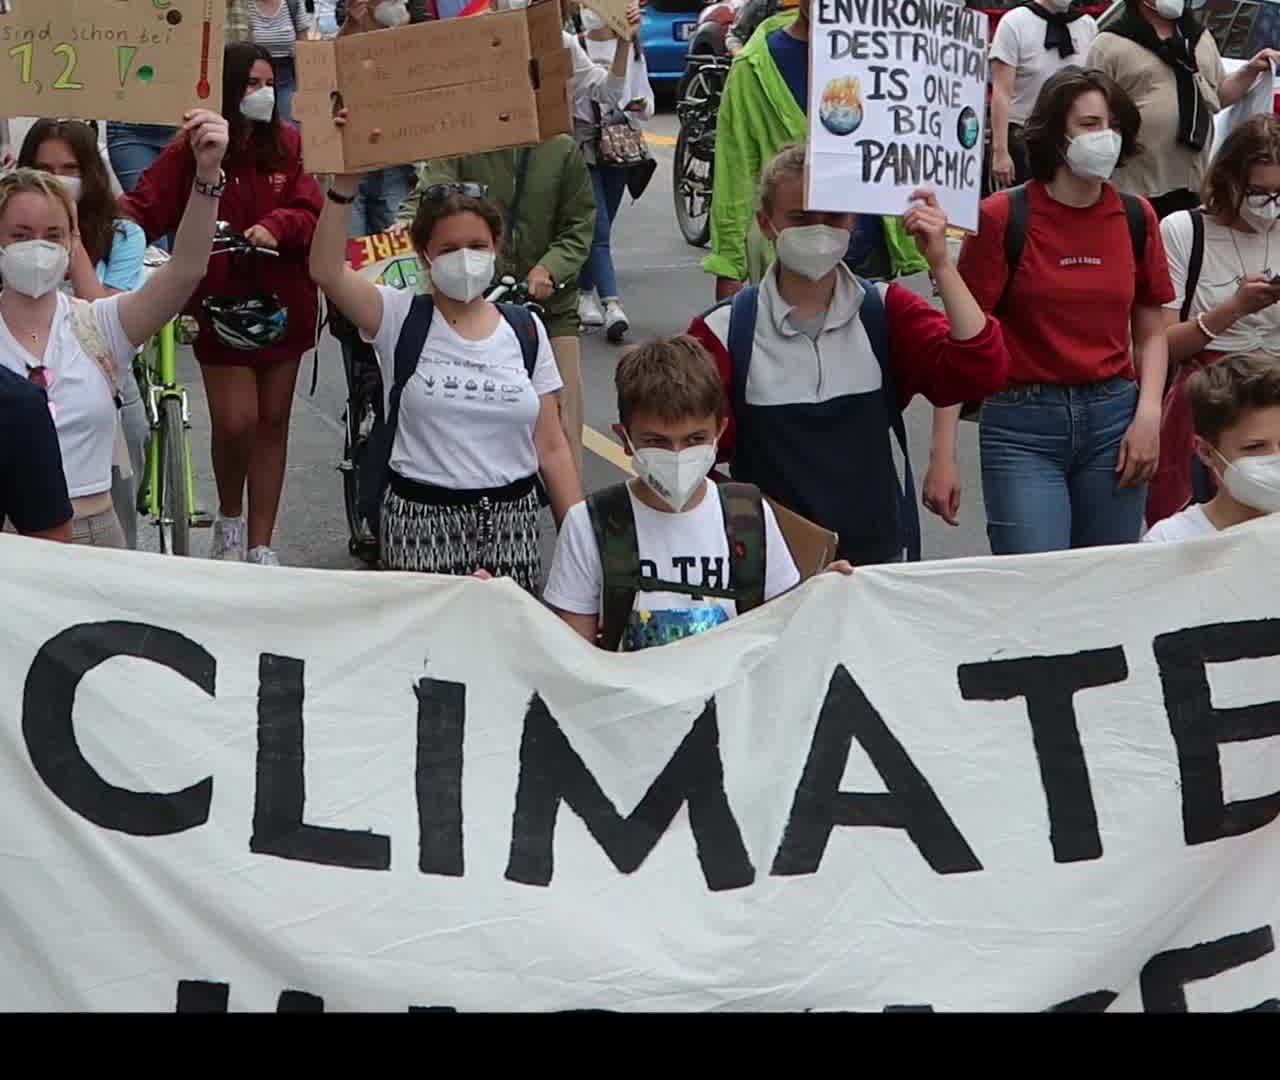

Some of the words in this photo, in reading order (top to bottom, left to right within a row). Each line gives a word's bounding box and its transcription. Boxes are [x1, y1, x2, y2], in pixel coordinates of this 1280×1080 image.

[2, 20, 52, 41] sind
[72, 20, 129, 41] schon
[140, 27, 173, 45] bei
[8, 41, 85, 96] 1,2
[827, 30, 986, 83] DESTRUCTION
[866, 65, 910, 101] IS
[924, 74, 963, 108] ONE
[888, 104, 941, 138] BIG
[855, 138, 977, 190] PANDEMIC
